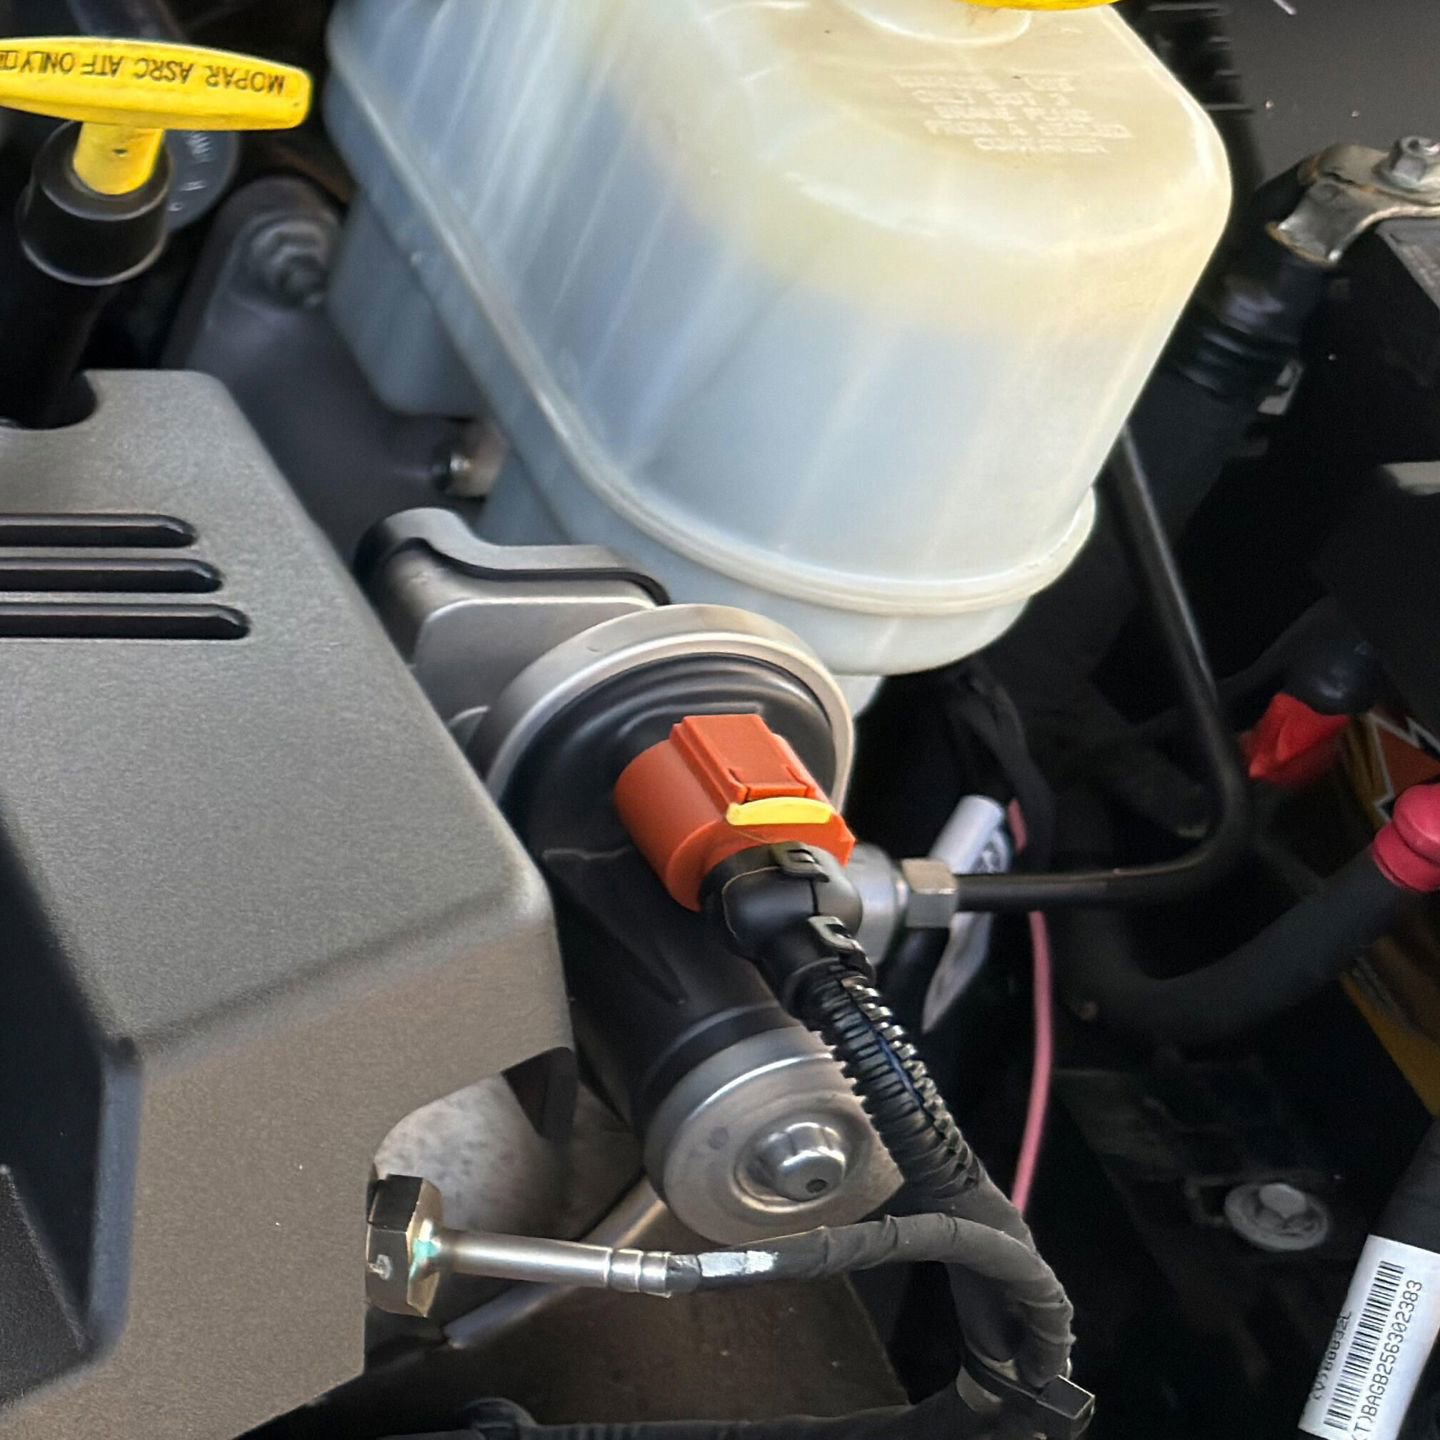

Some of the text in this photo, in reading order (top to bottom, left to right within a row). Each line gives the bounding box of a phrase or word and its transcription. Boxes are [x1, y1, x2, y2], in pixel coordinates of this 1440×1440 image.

[20, 50, 286, 95] MOPAR ASRC ATF ONLY
